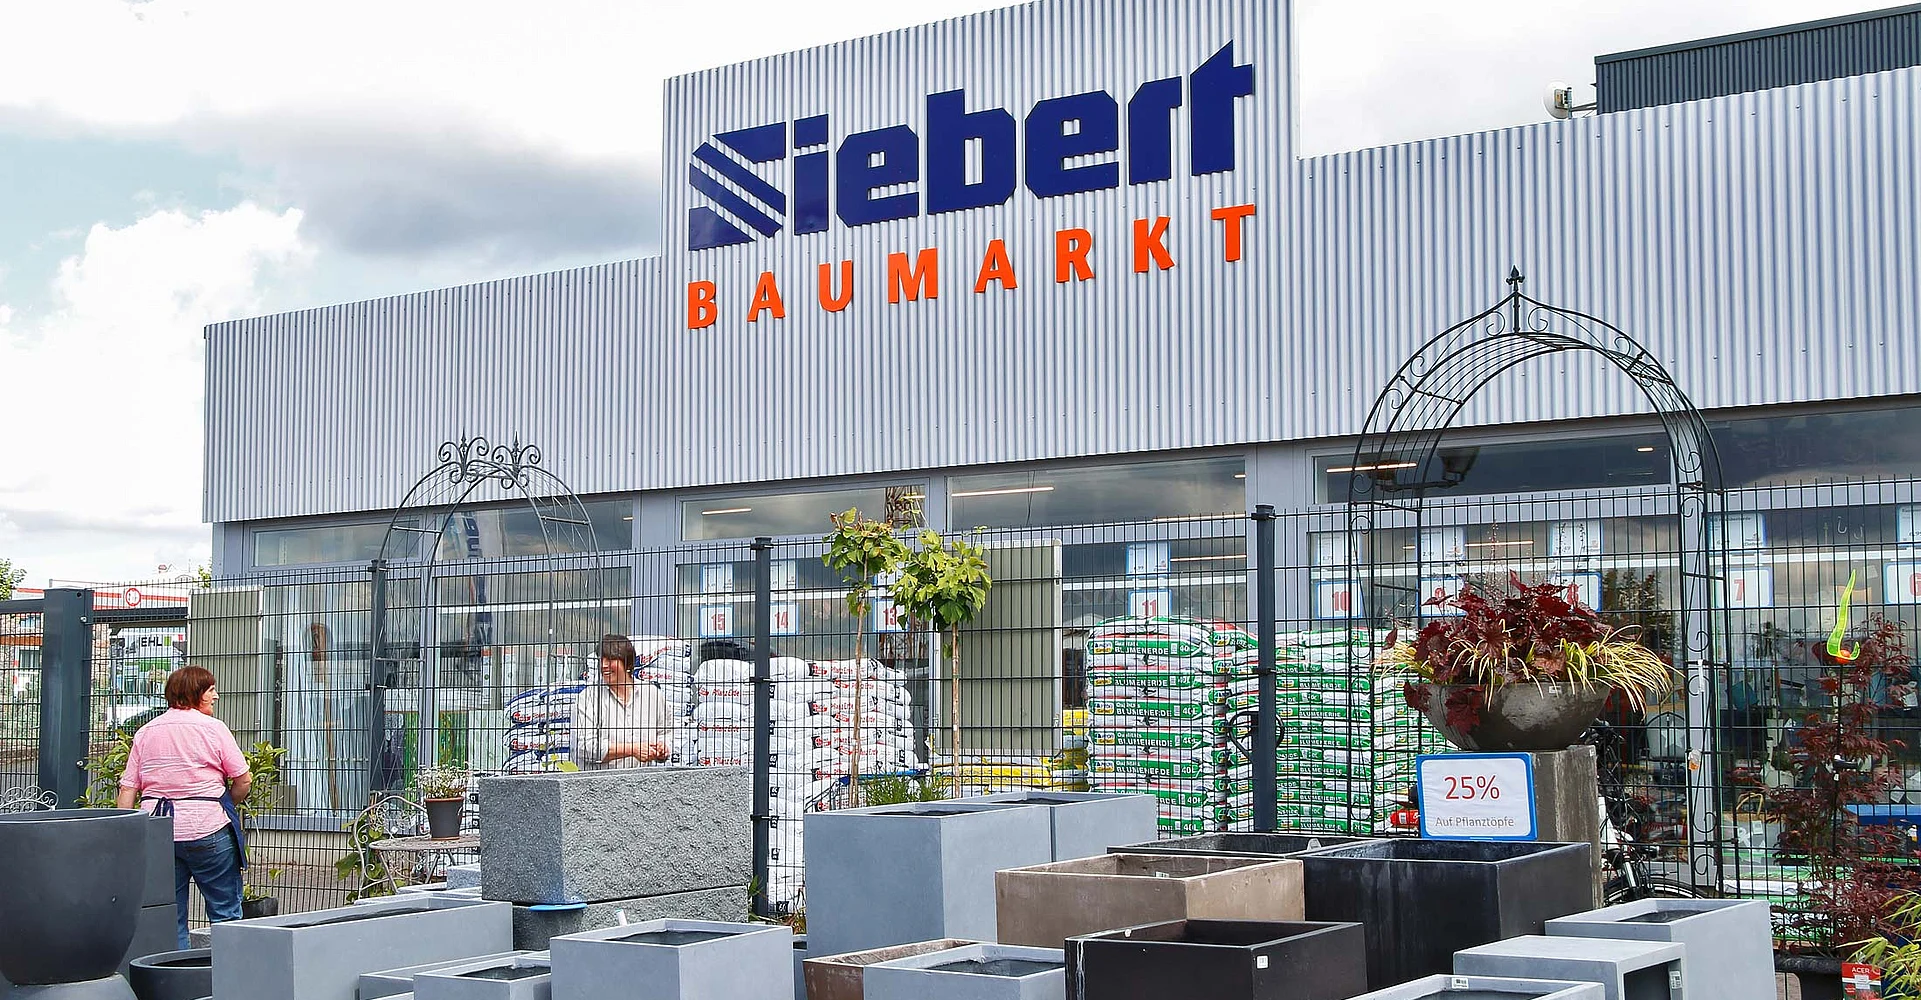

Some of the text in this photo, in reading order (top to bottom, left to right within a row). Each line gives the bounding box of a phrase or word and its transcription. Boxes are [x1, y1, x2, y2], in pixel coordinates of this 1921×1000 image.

[688, 39, 1254, 252] Siebert
[688, 204, 1256, 330] BAUMARKT
[1733, 578, 1744, 601] 7
[1141, 600, 1157, 617] 11
[1332, 590, 1350, 612] 10
[710, 613, 725, 631] 15
[774, 612, 789, 629] 14
[882, 607, 897, 626] 13
[141, 635, 163, 647] EHL
[1444, 775, 1501, 800] 25%
[1435, 816, 1514, 829] Auf Pflanztöpfe
